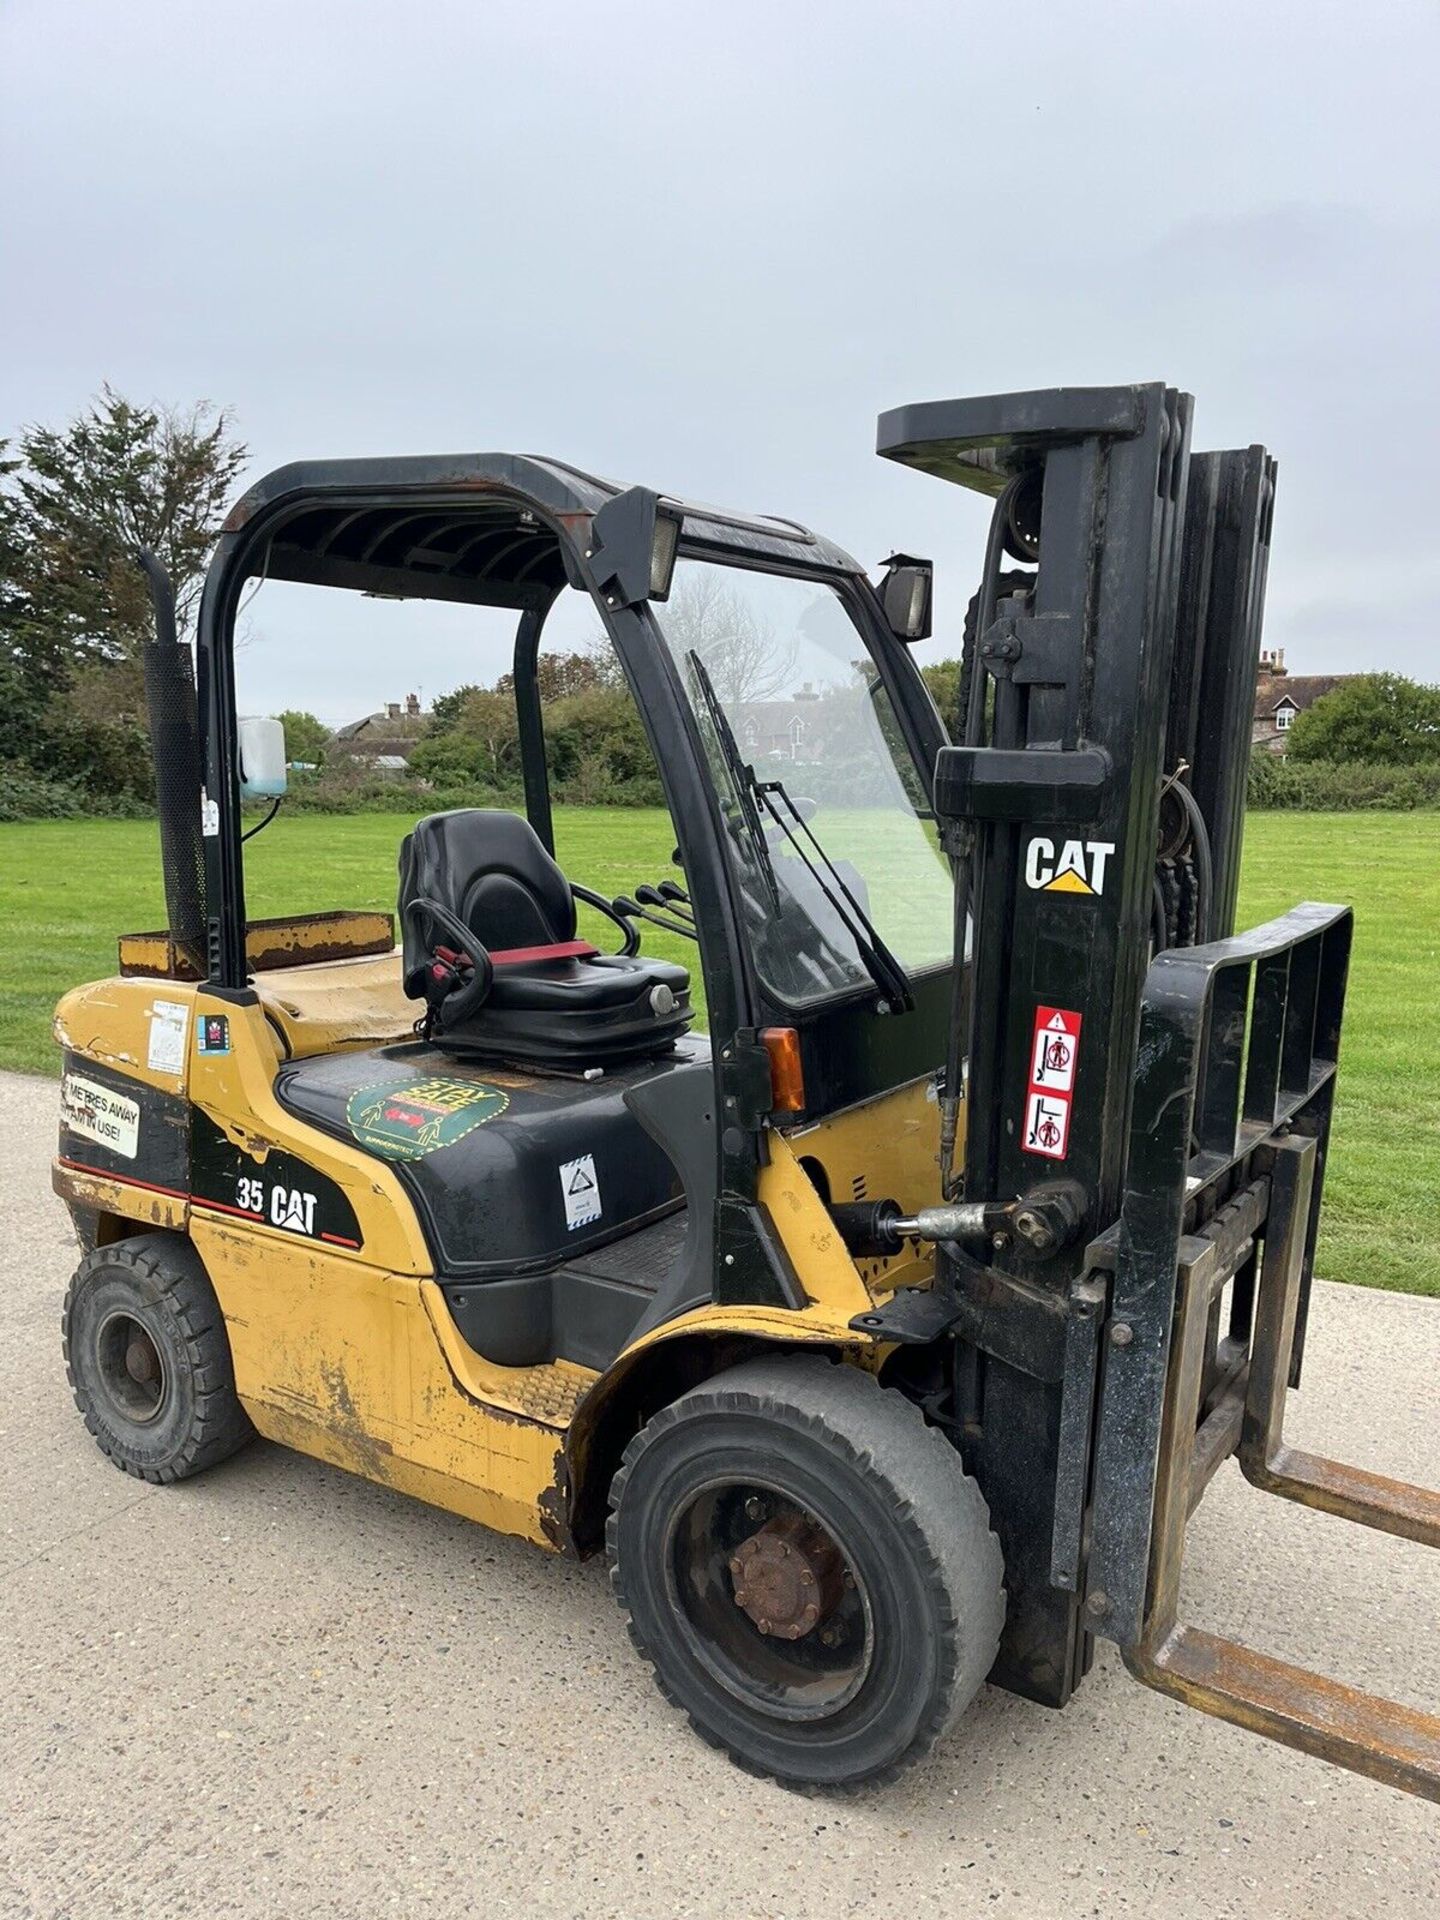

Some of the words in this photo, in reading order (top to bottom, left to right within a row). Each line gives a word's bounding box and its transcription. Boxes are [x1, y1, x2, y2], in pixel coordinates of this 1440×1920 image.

[1025, 837, 1116, 896] CAT
[69, 1081, 108, 1112] METRES
[108, 1102, 138, 1125] AWAY
[401, 1087, 478, 1113] SAFE
[423, 1080, 497, 1099] STAY
[97, 1119, 120, 1142] USE!
[236, 1177, 264, 1212] 35
[271, 1185, 318, 1235] CAT
